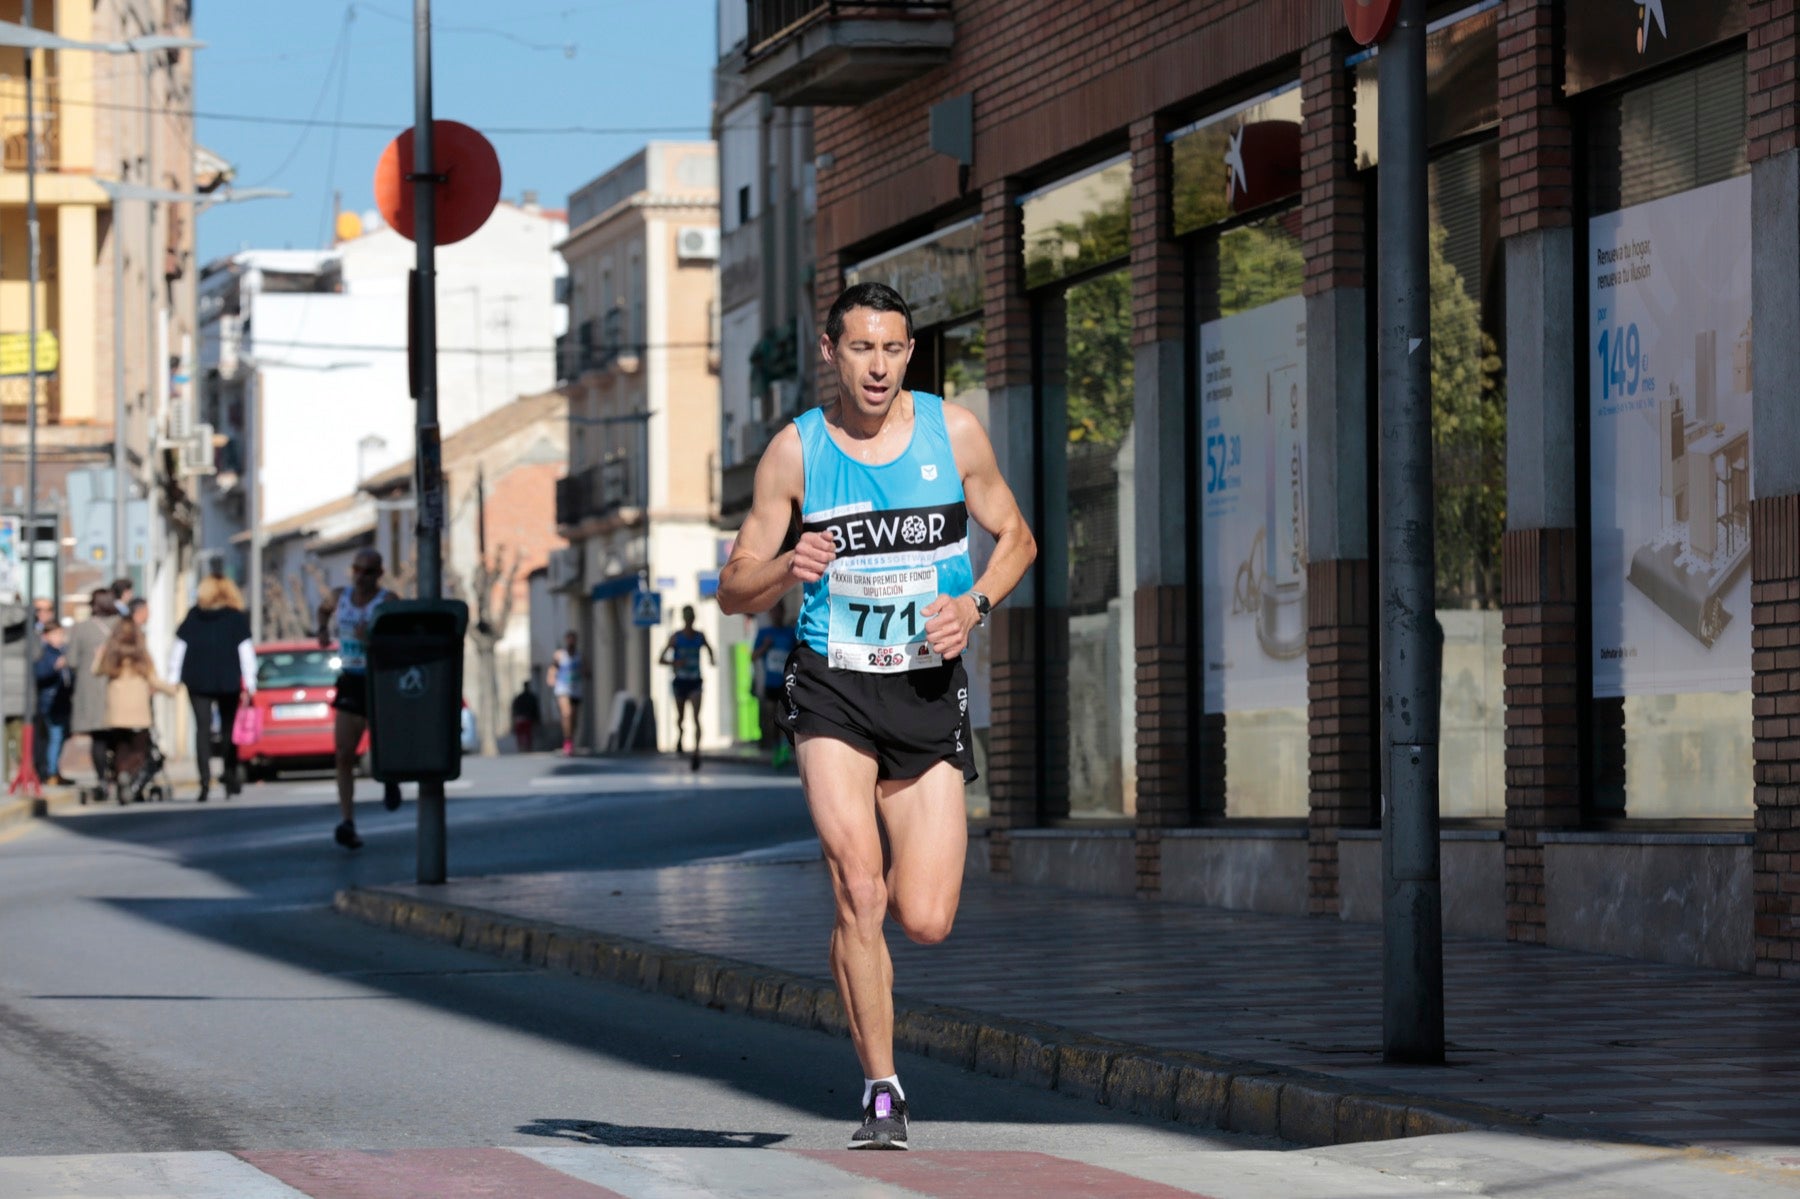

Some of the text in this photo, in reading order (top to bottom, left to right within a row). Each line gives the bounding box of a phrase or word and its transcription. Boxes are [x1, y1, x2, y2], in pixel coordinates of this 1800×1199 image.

[1597, 246, 1622, 266] Renueva
[1597, 270, 1621, 290] renueva
[1598, 323, 1640, 400] 149
[1642, 377, 1655, 393] mes
[854, 574, 872, 586] GRAN
[873, 573, 898, 586] PREMIO
[899, 571, 908, 583] DE
[863, 585, 904, 597] DIPUTACIÓN
[848, 601, 917, 640] 771
